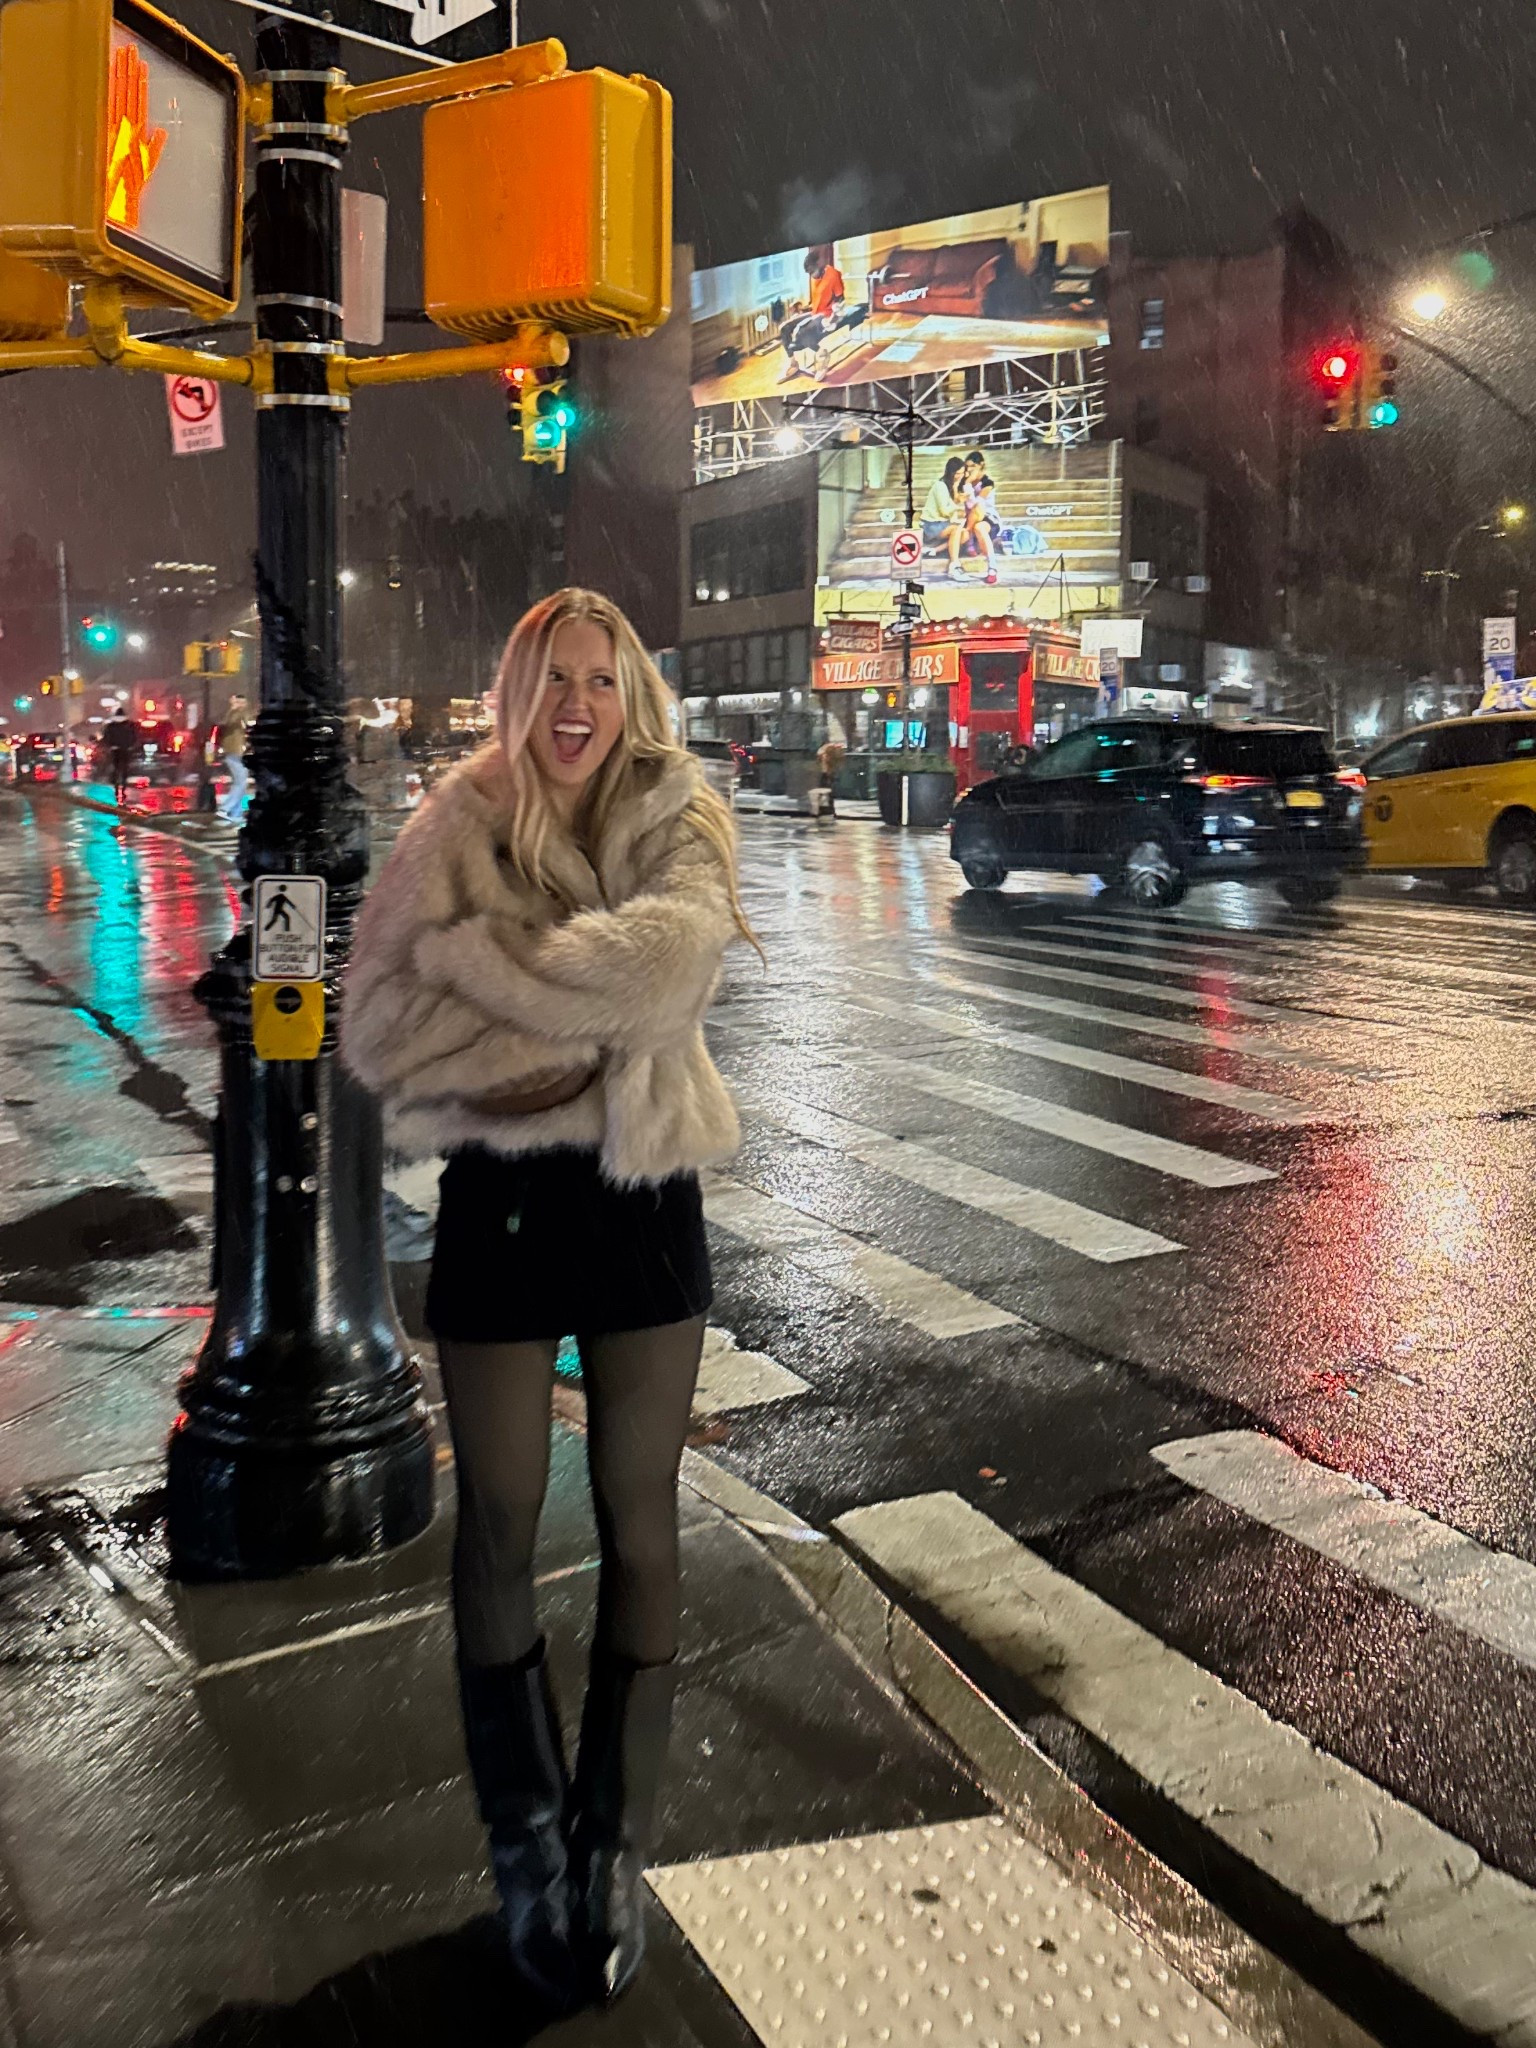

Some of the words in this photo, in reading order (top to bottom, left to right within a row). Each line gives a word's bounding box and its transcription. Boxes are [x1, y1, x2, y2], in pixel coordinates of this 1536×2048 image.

[1025, 505, 1074, 516] ChatGPT
[830, 625, 879, 637] VILLAGE
[831, 636, 877, 649] CIGARS
[1489, 637, 1511, 651] 20
[822, 659, 882, 683] VILLAGE
[887, 654, 945, 680] CIARS
[1101, 661, 1116, 672] 20
[275, 933, 302, 943] PUSH
[269, 953, 309, 963] AUDIBLE
[271, 963, 306, 973] SIGNAL
